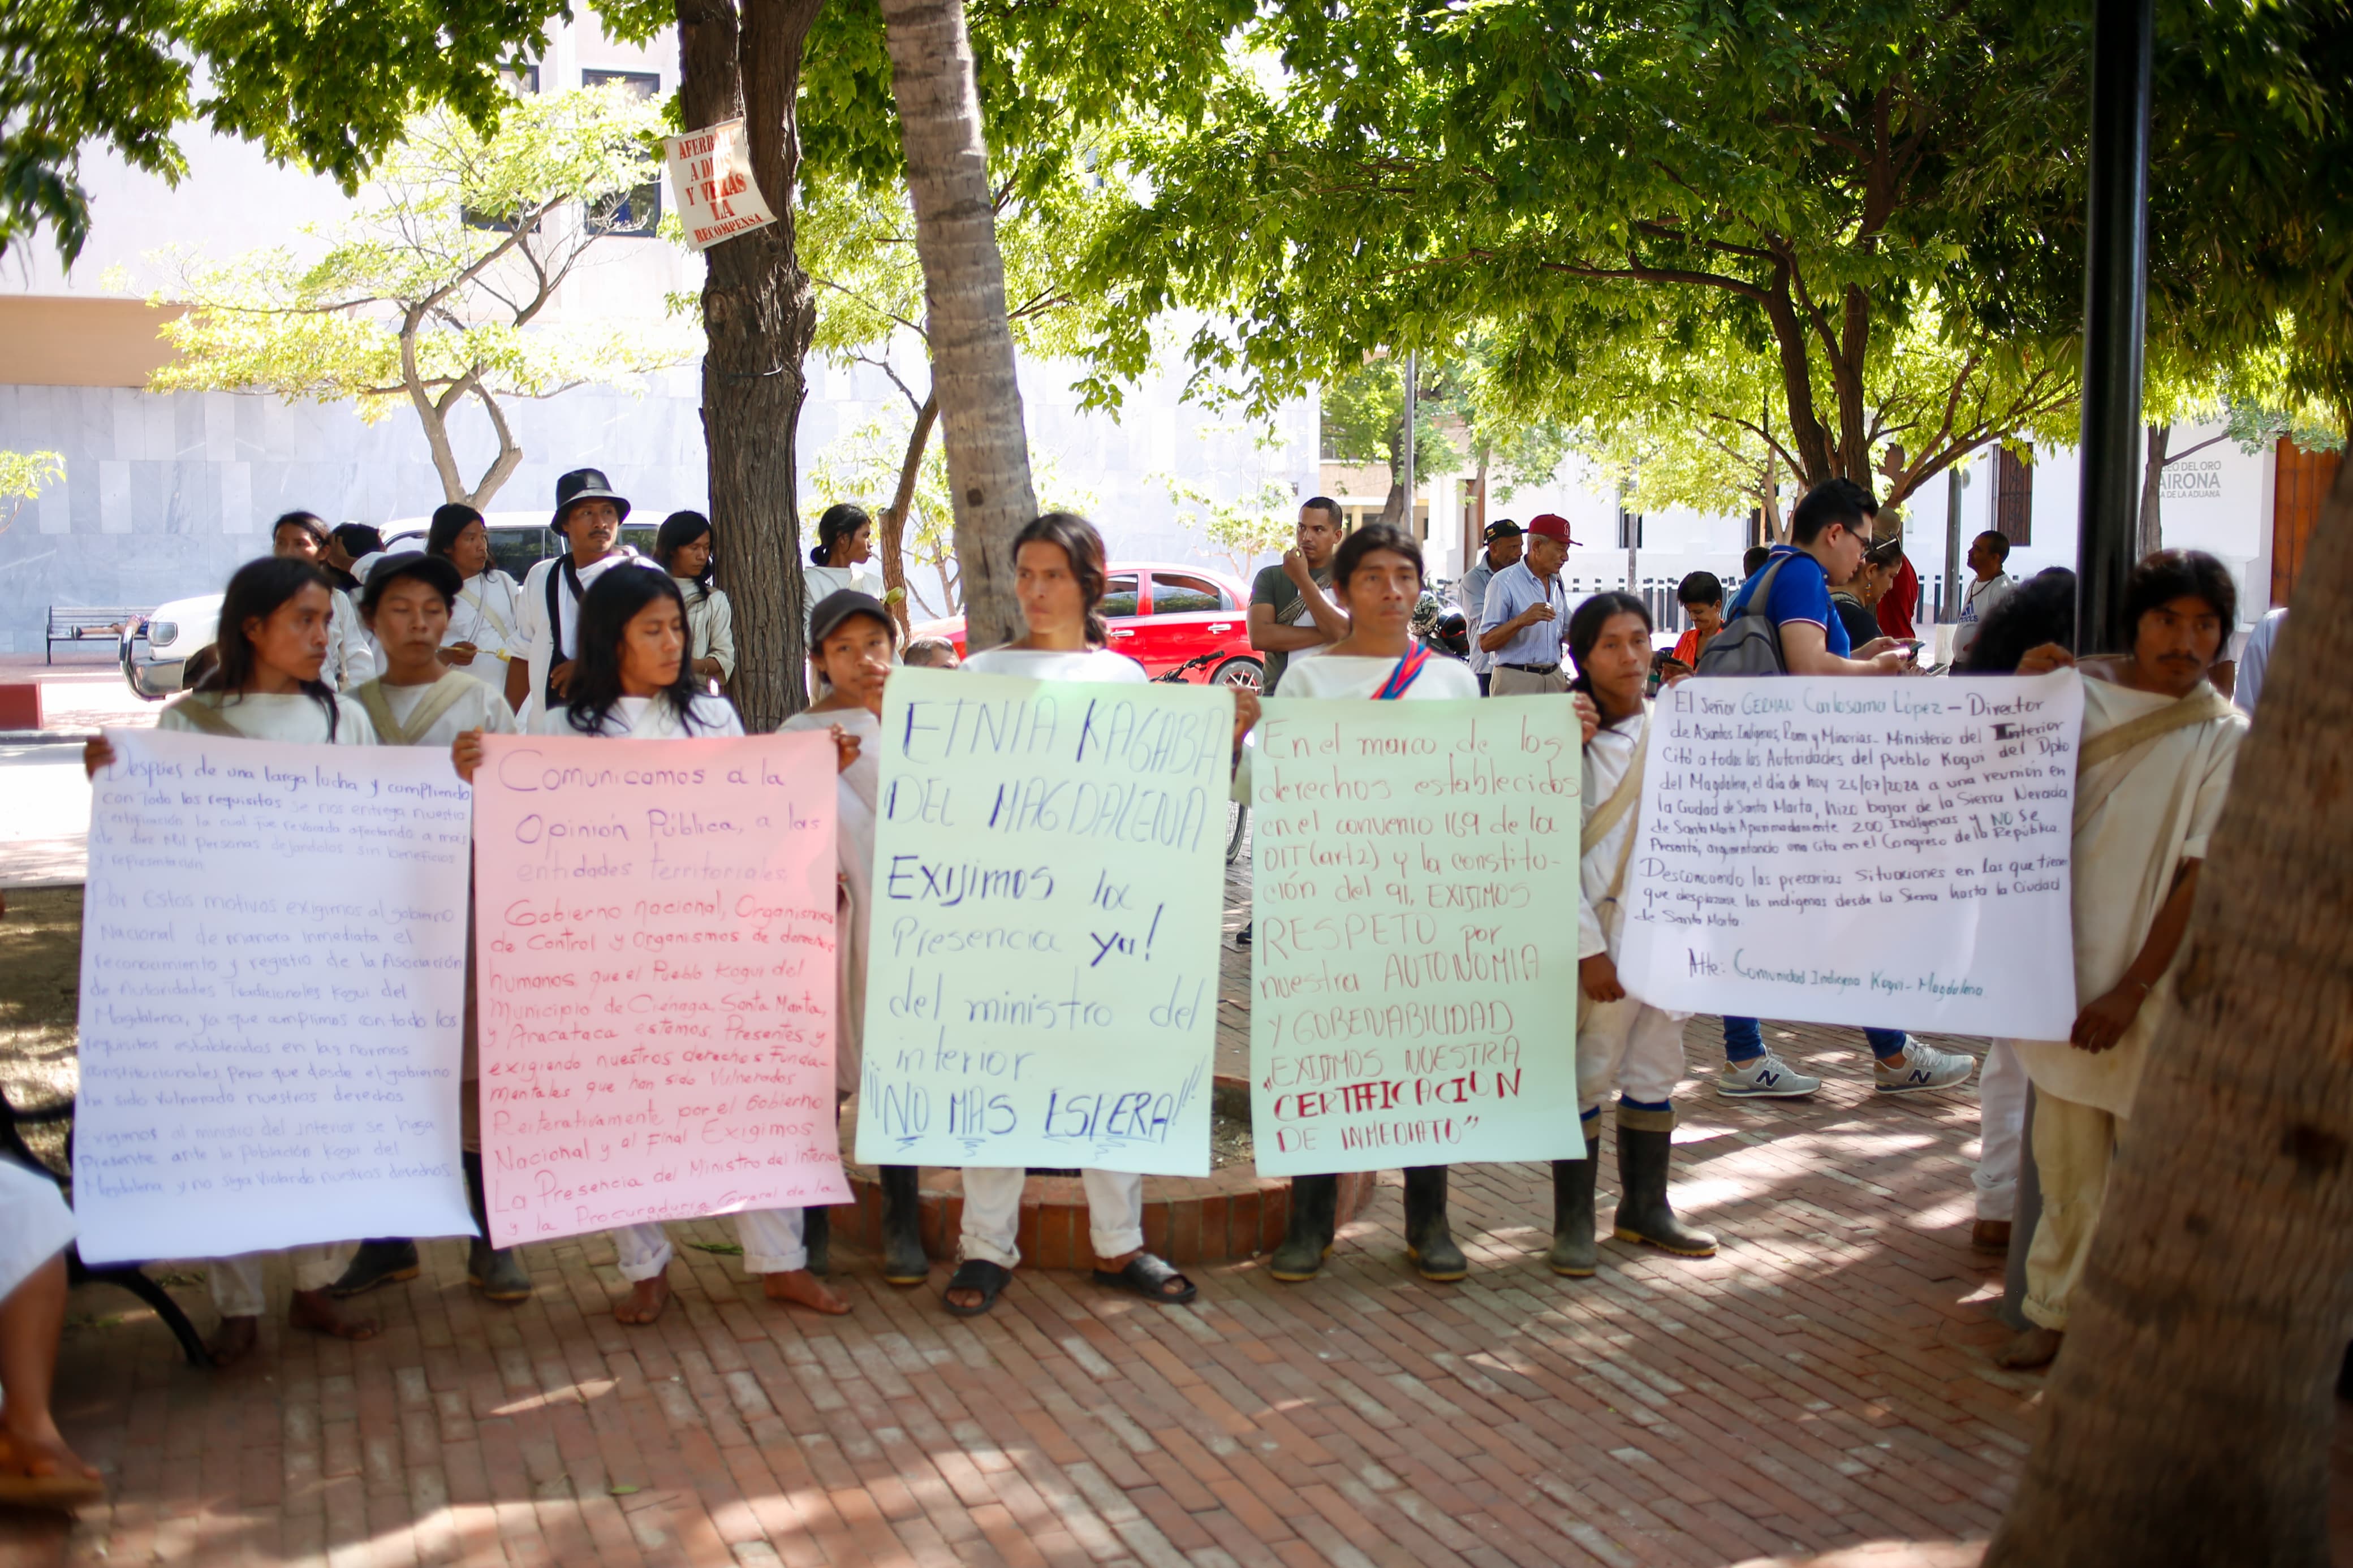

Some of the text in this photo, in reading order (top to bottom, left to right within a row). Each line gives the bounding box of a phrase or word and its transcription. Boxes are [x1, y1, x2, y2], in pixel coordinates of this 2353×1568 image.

[691, 163, 699, 182] A
[686, 172, 747, 206] Y VERÁS
[710, 200, 735, 221] LA
[695, 213, 763, 243] RECOMPENSA
[2181, 462, 2198, 470] DEL
[2200, 461, 2221, 470] ORO
[2160, 472, 2221, 490] AIRONA
[1674, 691, 1693, 714] El
[1966, 693, 2044, 716] Director
[903, 696, 1227, 784] ETNIA KAGABA
[1262, 714, 1562, 762] En el marco de los
[1887, 721, 2064, 745] Ministerio del Interior
[1768, 749, 1843, 767] Autoridades
[1851, 749, 1872, 766] del
[1999, 744, 2025, 758] del
[2039, 737, 2070, 757] Dpto
[194, 755, 358, 792] de una larga lucha
[498, 749, 785, 792] Comunicamos a la
[1259, 753, 1579, 804] derechos establecidos
[1929, 761, 2066, 791] a una reunión en
[180, 792, 201, 805] los
[208, 793, 282, 813] requisitos
[884, 775, 1206, 852] DEL MAGDALENA
[1867, 784, 2067, 817] bajar de la Sierra Nevada
[515, 813, 630, 860] Opinión
[755, 815, 770, 828] a
[788, 802, 820, 831] las
[1261, 805, 1559, 839] en el convenio 169 de la
[1852, 814, 2013, 833] 200 NO
[1421, 841, 1441, 875] la
[1882, 834, 1947, 854] Congreso
[517, 854, 632, 883] entidades
[1753, 858, 2002, 892] las precarias las
[1335, 875, 1371, 903] del
[1644, 888, 1668, 908] que
[1950, 884, 1987, 900] hasta
[204, 890, 362, 921] motivos exigimos
[504, 897, 621, 926] Gobierno
[301, 926, 413, 945] inmediata el
[490, 931, 515, 954] de
[893, 915, 1061, 957] Presencia
[1262, 912, 1437, 966] RESPETO
[489, 958, 575, 994] humanos
[589, 970, 620, 991] que
[626, 966, 642, 983] el
[772, 959, 804, 978] del
[1260, 944, 1539, 1000] nuestra AUTONOMIA
[1919, 972, 1984, 1001] Magdalena
[604, 997, 622, 1014] de
[721, 990, 770, 1013] Santa
[889, 966, 1205, 1031] del ministro del
[511, 1023, 619, 1044] Aracataca
[489, 1040, 762, 1082] exigiendo nuestros derechos
[897, 1025, 1035, 1081] interior
[1405, 1035, 1520, 1075] NUESTRA
[586, 1078, 616, 1103] que
[628, 1078, 654, 1092] han
[665, 1069, 695, 1086] sido
[1756, 1069, 1780, 1088] N
[1906, 1069, 1932, 1085] N
[247, 1088, 403, 1103] nuestros derechos
[678, 1094, 823, 1119] por el Gobierno
[950, 1086, 1017, 1135] MAS
[495, 1138, 591, 1172] Nacional
[622, 1131, 636, 1147] al
[647, 1130, 688, 1156] Final
[701, 1119, 815, 1144] Exigimos
[1277, 1127, 1318, 1153] DE
[495, 1151, 789, 1212] La Presencia del Ministro del
